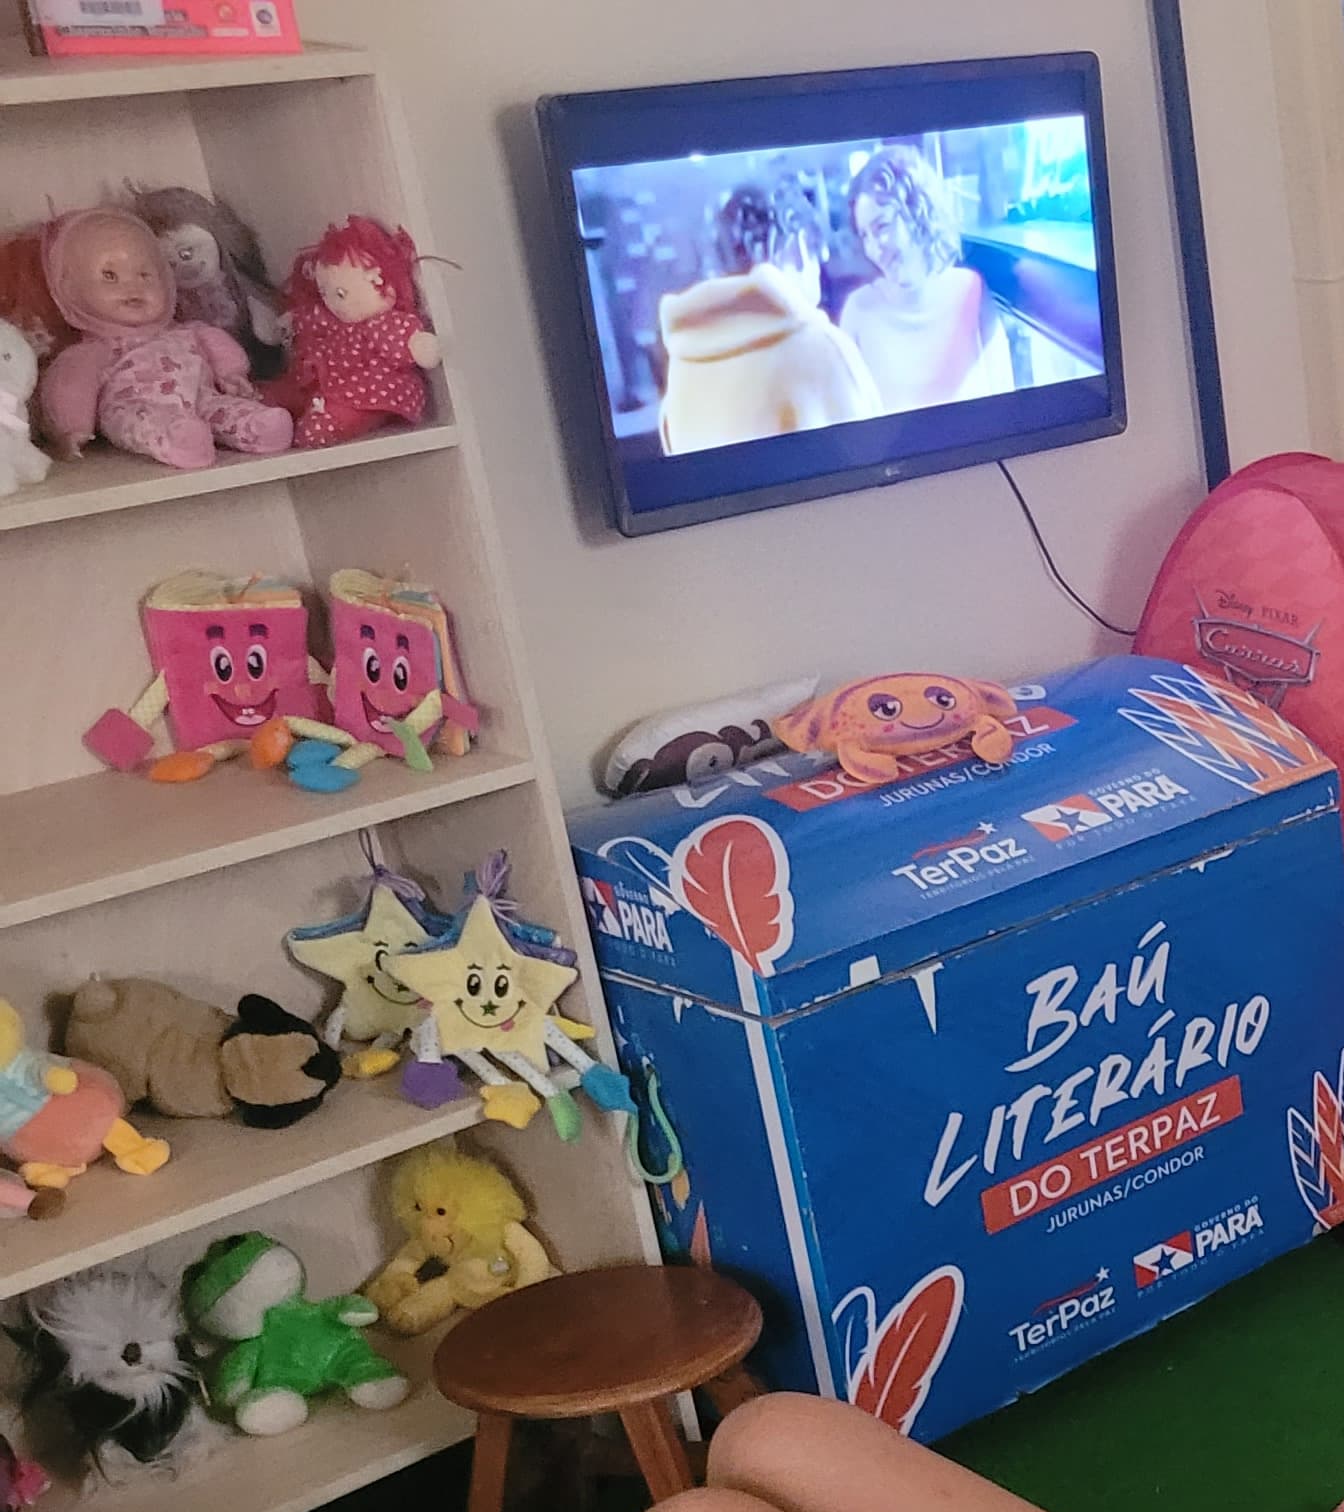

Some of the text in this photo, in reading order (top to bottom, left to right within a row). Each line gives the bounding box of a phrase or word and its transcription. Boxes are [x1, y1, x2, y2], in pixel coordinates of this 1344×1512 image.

[892, 838, 1028, 891] TerPaz
[1004, 921, 1170, 1072] BAÚ
[924, 995, 1270, 1207] LITERÁRIO
[1009, 1092, 1221, 1217] DO TERPAZ
[1046, 1147, 1205, 1233] JURUNAS/CONDOR
[1194, 1195, 1259, 1232] GOVERNO DO
[1196, 1204, 1264, 1258] PARÁ
[1008, 1286, 1116, 1352] TerPaz
